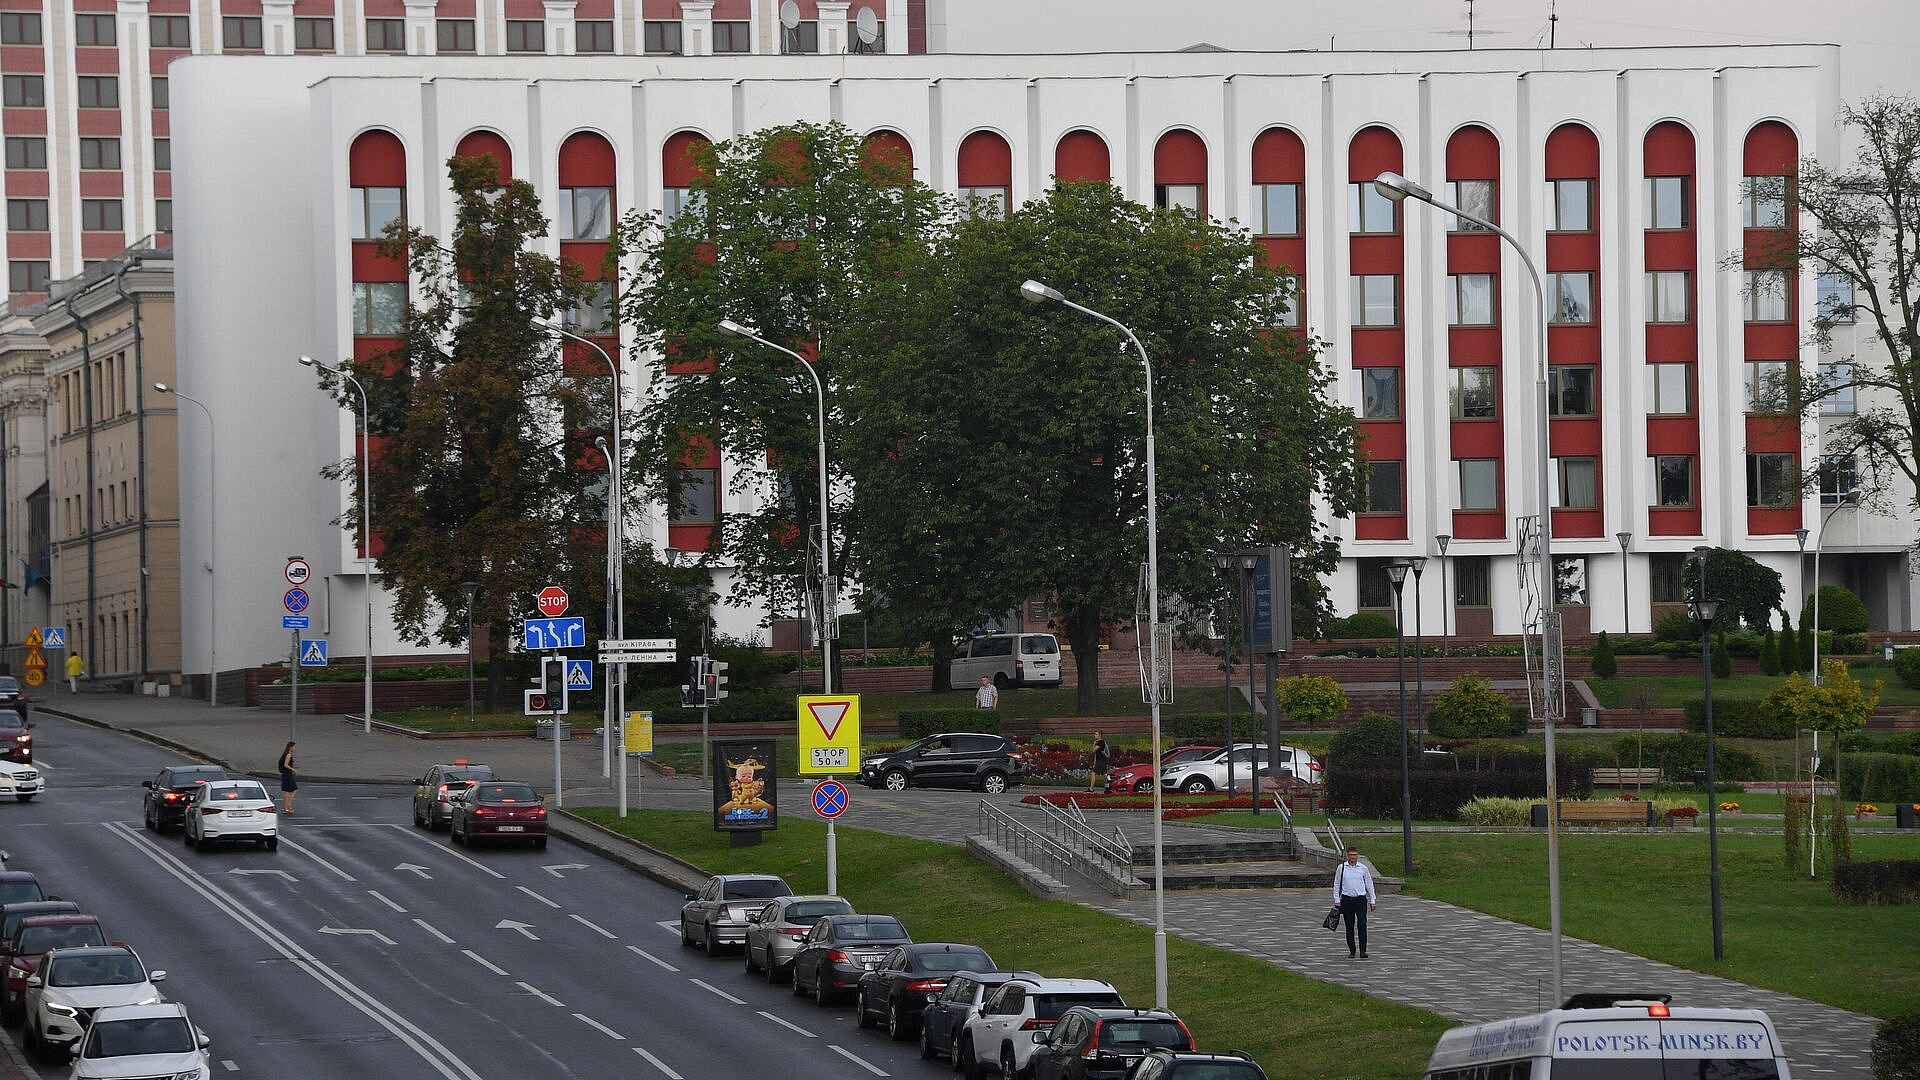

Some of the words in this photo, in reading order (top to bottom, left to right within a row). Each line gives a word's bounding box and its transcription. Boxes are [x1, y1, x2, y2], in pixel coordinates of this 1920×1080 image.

[540, 596, 566, 607] STOP
[818, 757, 831, 766] 50
[1557, 1034, 1764, 1052] POLOTSK-MINSK.BY
